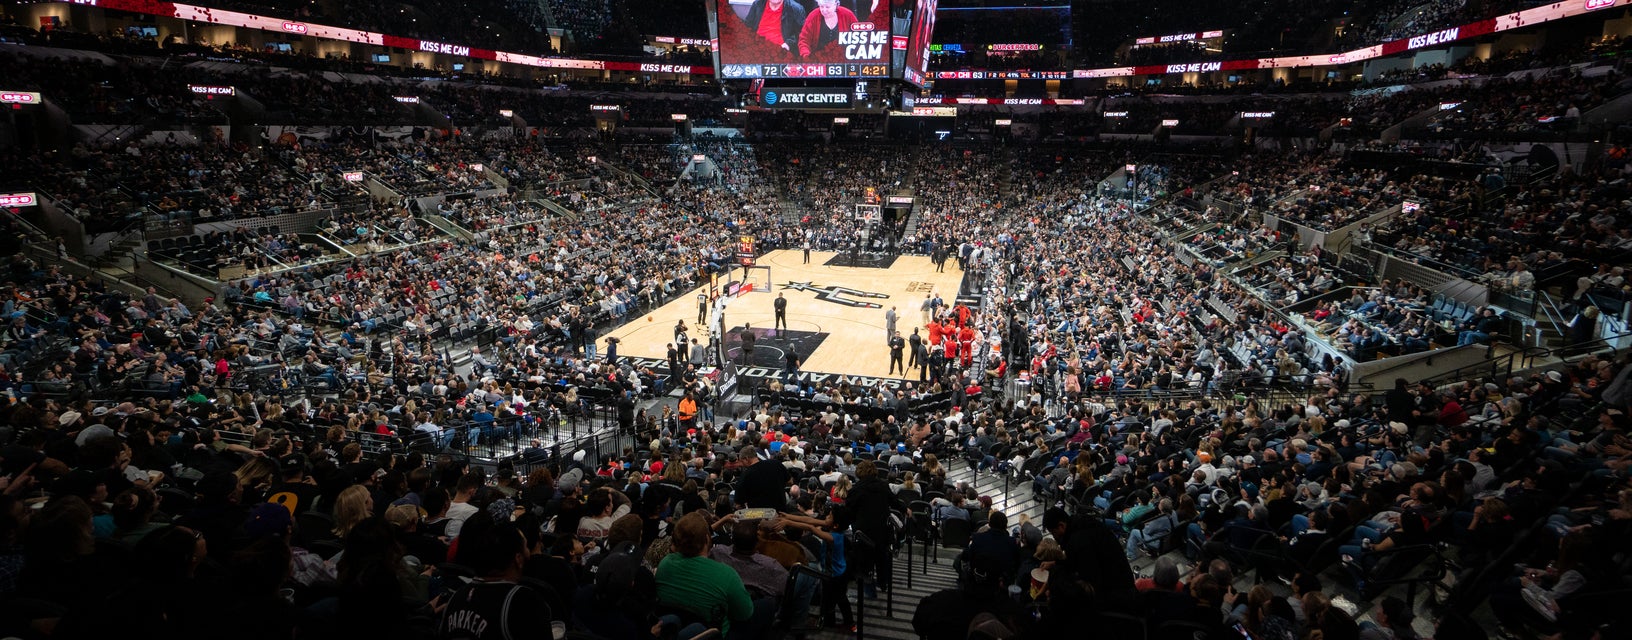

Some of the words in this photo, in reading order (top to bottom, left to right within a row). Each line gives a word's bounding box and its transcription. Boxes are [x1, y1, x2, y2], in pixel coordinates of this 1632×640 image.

[838, 32, 868, 44] KISS
[870, 31, 888, 44] ME
[1408, 36, 1426, 50] KISS
[1427, 32, 1439, 45] ME
[1440, 28, 1459, 43] CAM
[420, 40, 439, 52] KISS
[440, 43, 452, 54] ME
[453, 45, 470, 56] CAM
[845, 45, 882, 60] CAM
[641, 64, 659, 72] KISS
[661, 64, 672, 72] ME
[674, 65, 690, 74] CAM
[745, 66, 758, 75] SA
[764, 66, 777, 75] 72
[806, 66, 824, 75] CHI
[828, 66, 842, 75] 63
[862, 66, 886, 75] 4:21
[1166, 64, 1186, 73] KISS
[1187, 63, 1200, 72] ME
[1201, 62, 1221, 71] CAM
[780, 94, 805, 103] AT&T
[806, 94, 847, 103] CENTER
[448, 610, 488, 638] PARKER
